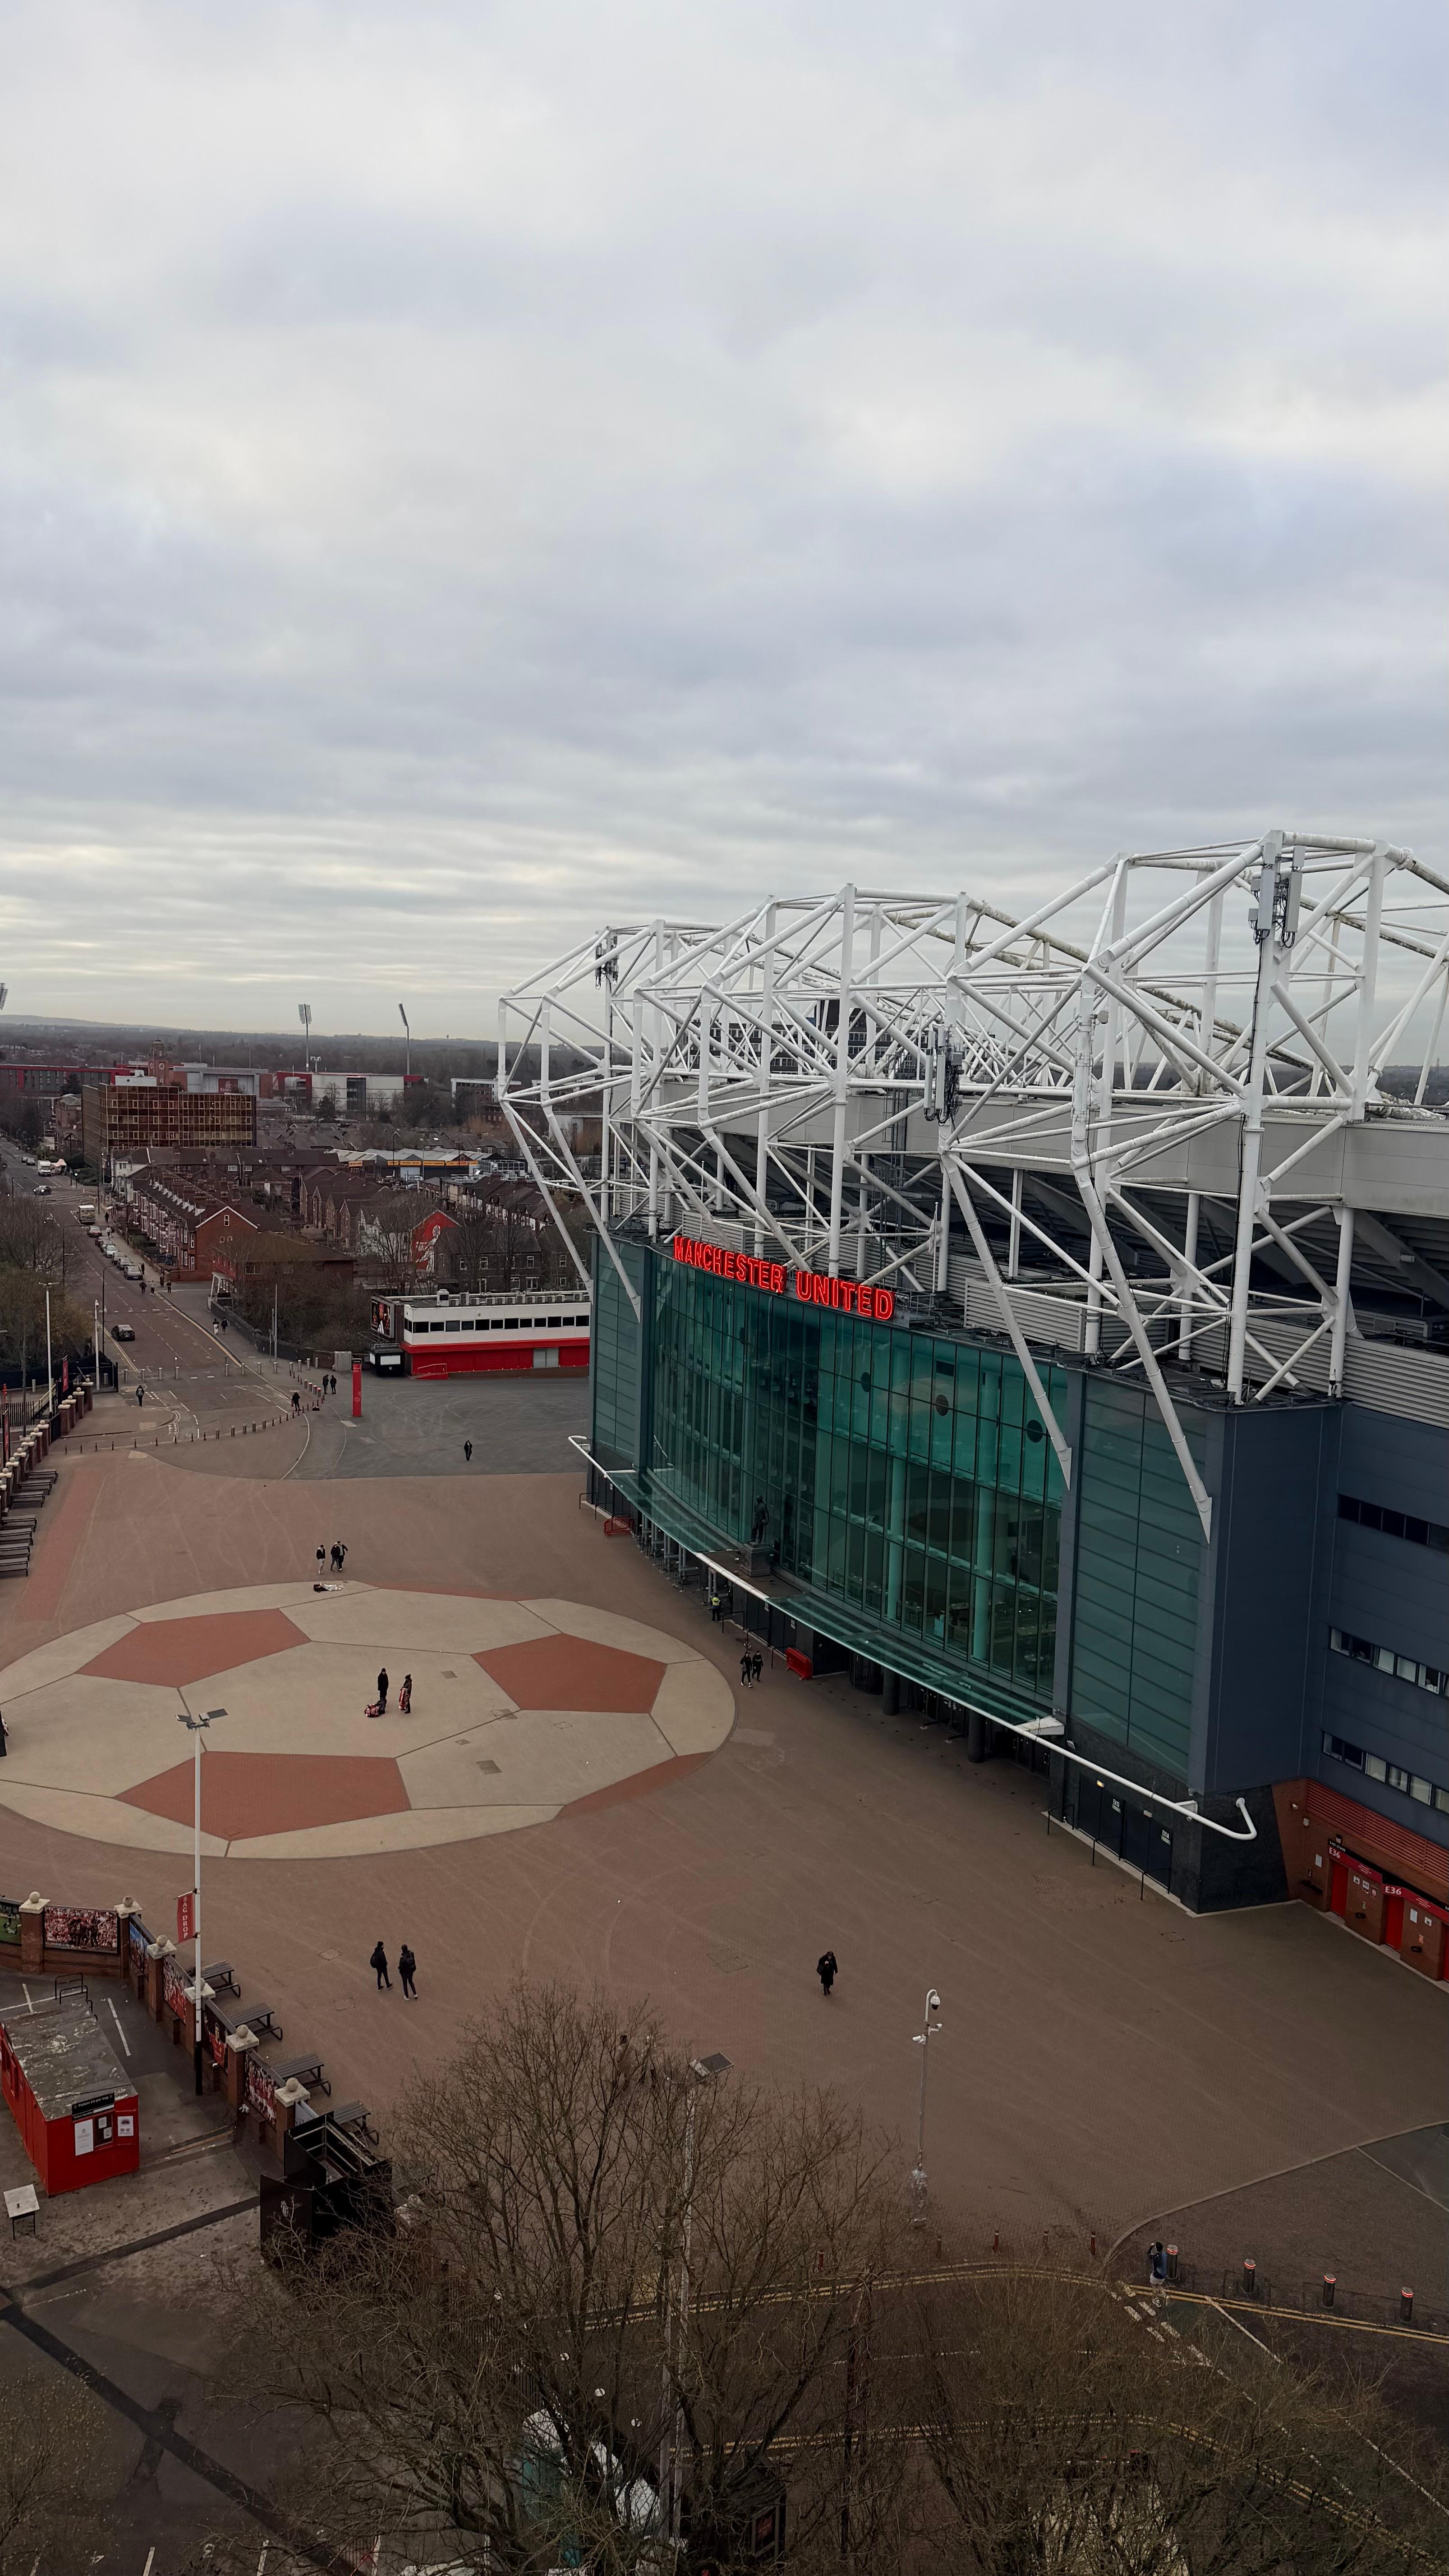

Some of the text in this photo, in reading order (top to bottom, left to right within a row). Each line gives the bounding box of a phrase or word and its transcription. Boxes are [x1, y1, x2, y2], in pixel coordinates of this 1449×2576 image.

[674, 1235, 894, 1320] MANCHESTER UNITED
[1329, 1847, 1340, 1858] E36
[1385, 1886, 1402, 1895] E36
